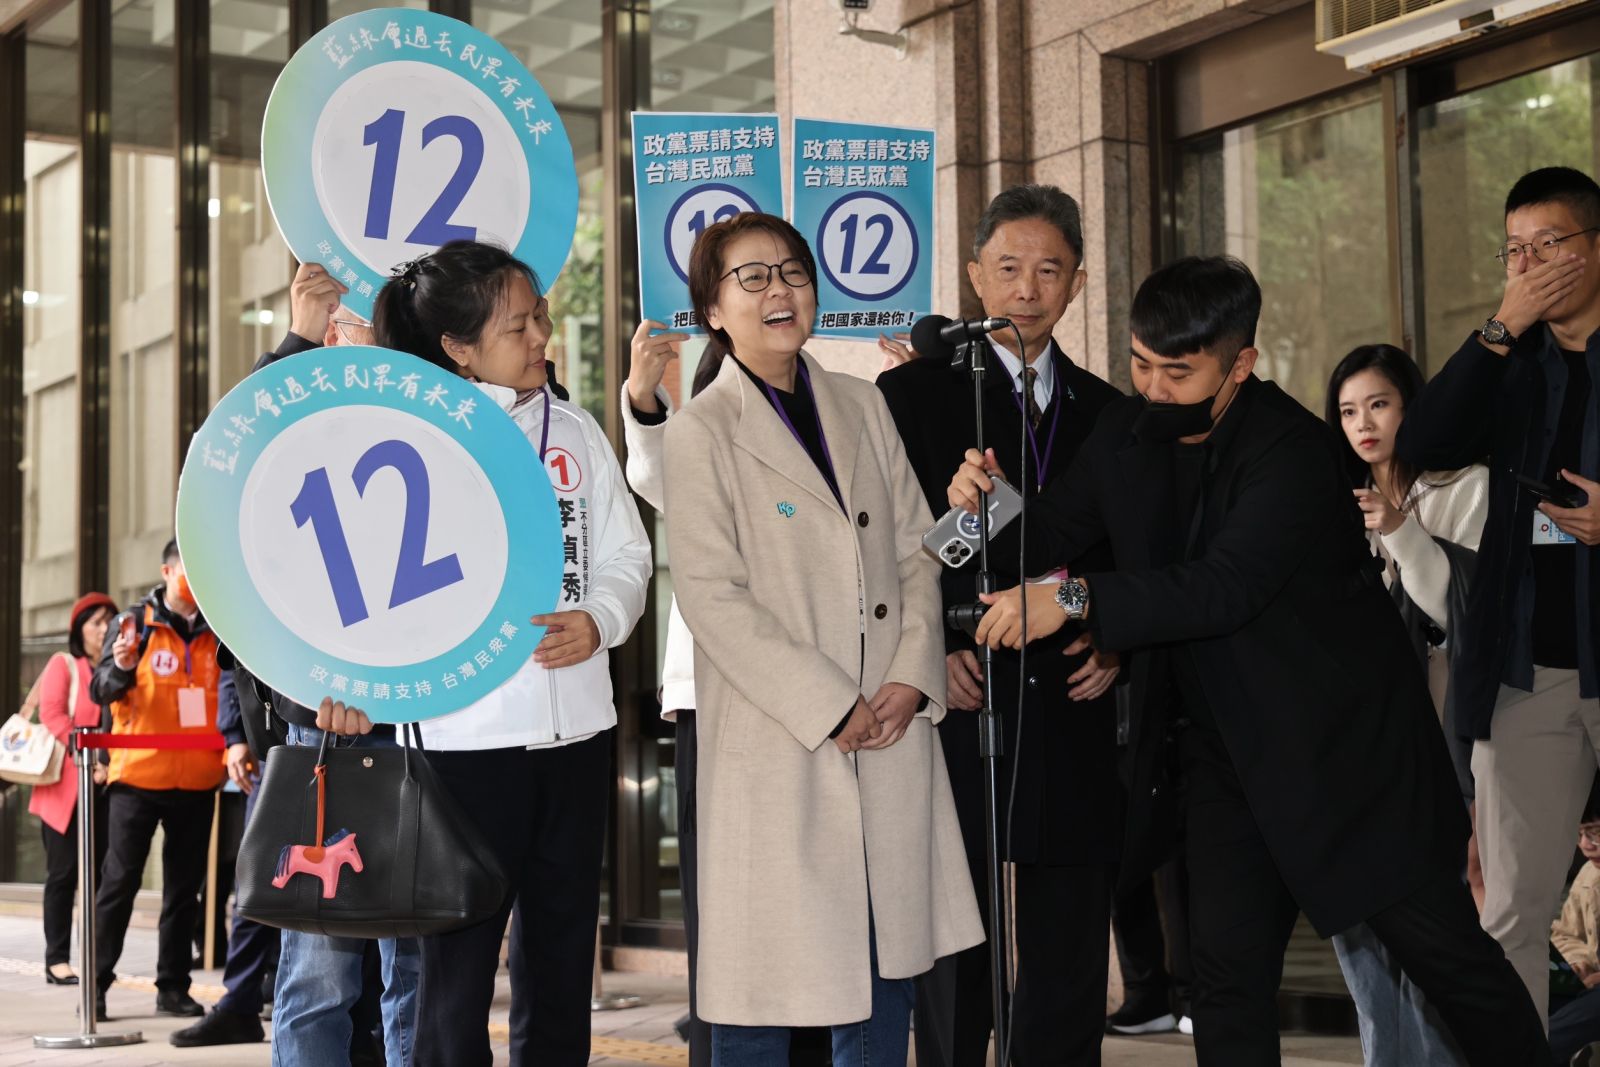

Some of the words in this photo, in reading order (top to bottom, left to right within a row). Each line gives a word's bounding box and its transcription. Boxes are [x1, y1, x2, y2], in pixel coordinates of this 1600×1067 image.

[643, 124, 775, 156] 政黨票請支持
[803, 138, 930, 161] 政黨票請支持
[363, 108, 485, 247] 12
[645, 153, 754, 184] 台灣民眾黨
[803, 165, 908, 187] 台灣民眾黨
[688, 204, 740, 240] 1
[840, 213, 894, 275] 12
[316, 239, 379, 302] 政黨票請
[550, 454, 569, 486] 1
[289, 439, 464, 629] 12
[558, 498, 581, 603] 李貞秀
[155, 654, 173, 669] 14
[309, 663, 433, 699] 政黨票請支持
